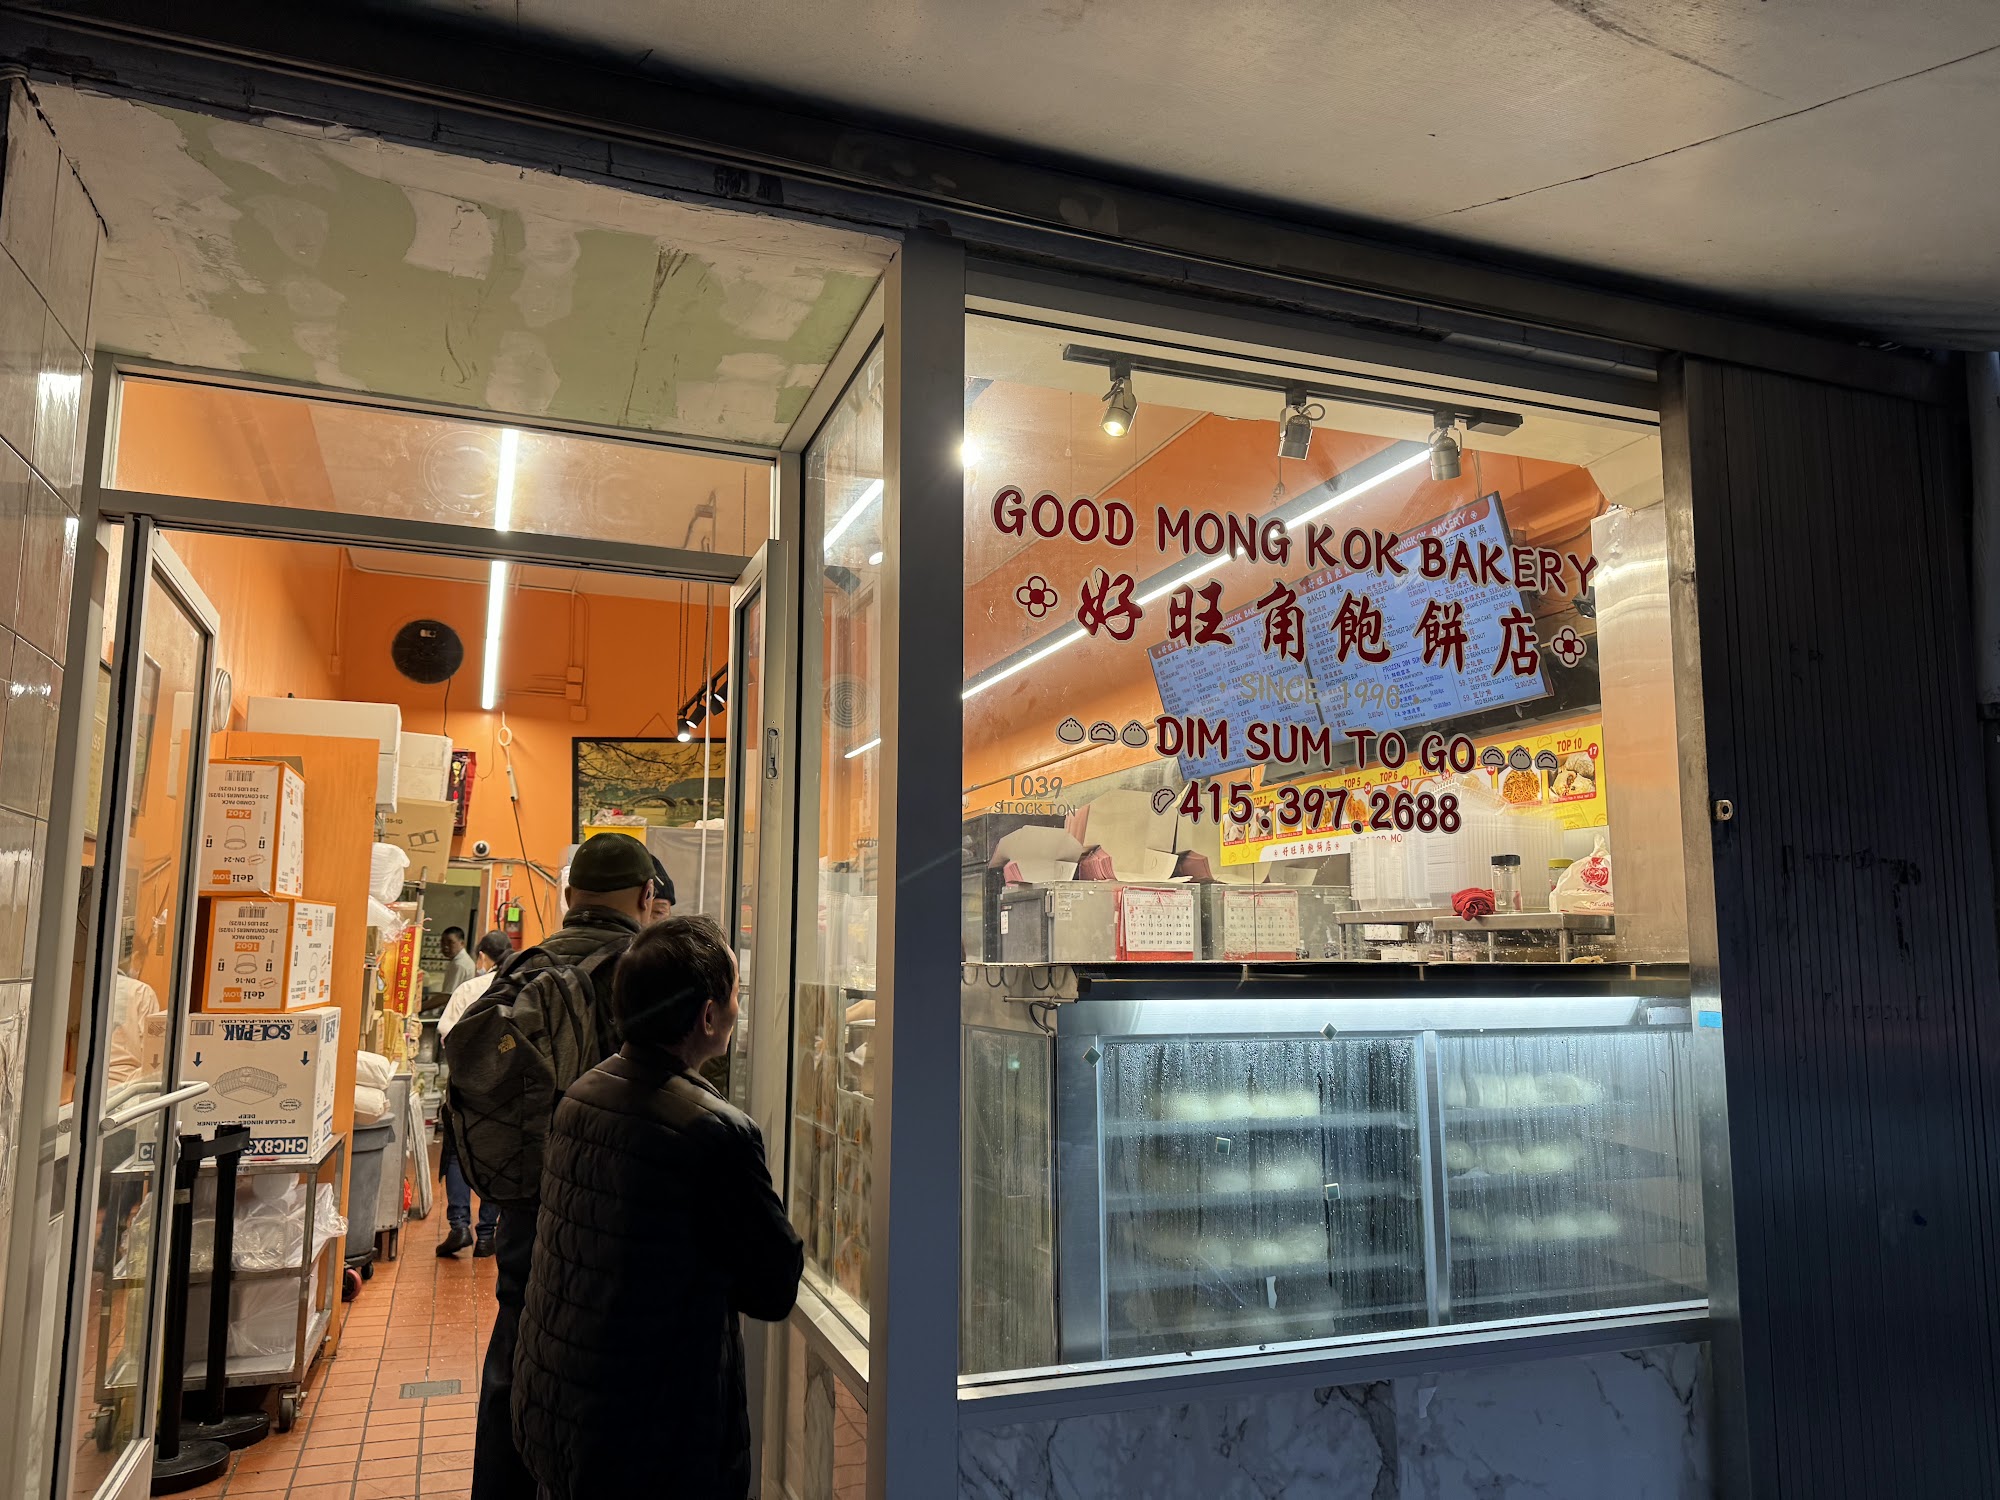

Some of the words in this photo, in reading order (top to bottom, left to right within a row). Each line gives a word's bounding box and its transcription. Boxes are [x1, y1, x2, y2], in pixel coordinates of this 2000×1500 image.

[1431, 512, 1467, 537] BAKERY
[992, 487, 1135, 547] GOOD
[1156, 505, 1292, 565] MONG
[1307, 524, 1407, 575] KOK
[1418, 535, 1598, 597] BAKERY
[1444, 531, 1465, 547] EETS
[1306, 589, 1327, 604] BAKED
[1076, 565, 1546, 676] 好旺角飽餅店
[1240, 674, 1320, 704] SINCE
[1340, 680, 1400, 710] 1996
[1155, 715, 1229, 761] DIM
[1245, 721, 1332, 767] SUM
[1344, 728, 1407, 770] TO
[1420, 734, 1476, 774] GO
[1557, 740, 1571, 753] TOP
[1574, 738, 1582, 750] 10
[1589, 747, 1597, 755] 17
[1344, 779, 1356, 788] TOP
[1380, 773, 1392, 783] TOP
[1008, 775, 1063, 799] 1039
[227, 809, 251, 818] 24oz
[994, 800, 1076, 817] STOCKTON
[1178, 779, 1461, 834] 415.397.2688
[236, 943, 258, 951] 16oz
